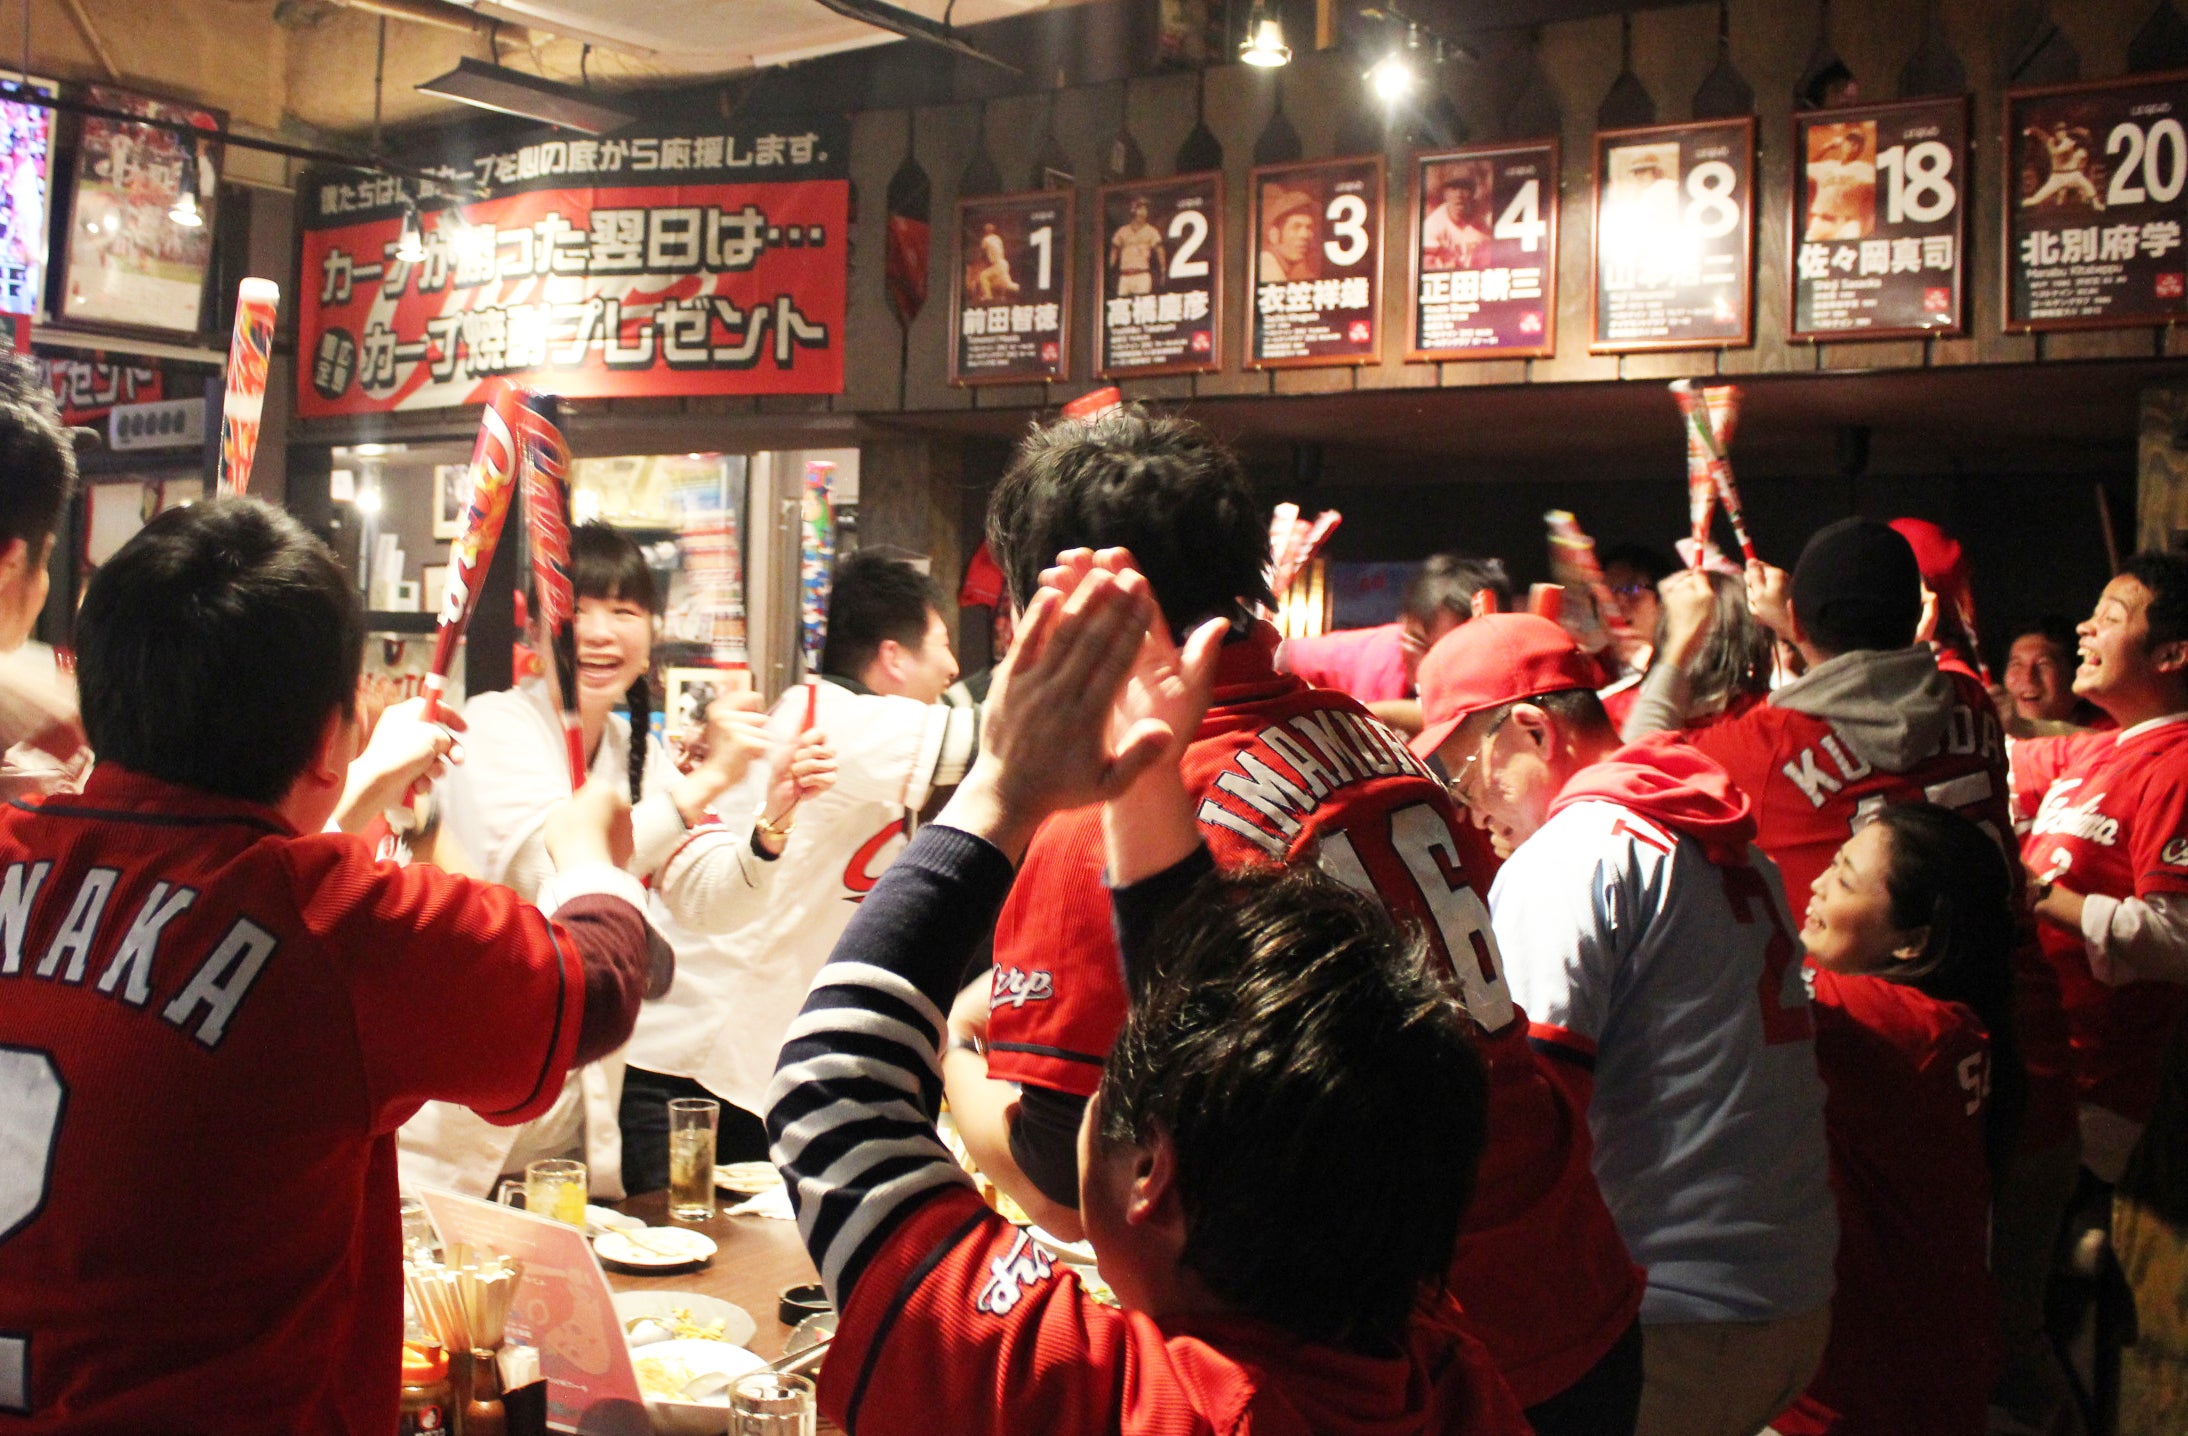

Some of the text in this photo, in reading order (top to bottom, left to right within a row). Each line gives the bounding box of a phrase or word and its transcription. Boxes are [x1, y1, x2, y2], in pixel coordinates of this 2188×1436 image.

[1877, 141, 1956, 224] 18
[2106, 118, 2187, 206] 20
[1323, 194, 1369, 267] 3
[1494, 178, 1546, 252] 4
[1683, 160, 1741, 240] 8
[1029, 226, 1053, 291] 1
[1168, 209, 1210, 279] 2
[1603, 254, 1736, 291] 山二
[1797, 235, 1953, 280] 佐々岡真司
[2020, 220, 2181, 266] 北別府学
[1257, 276, 1369, 314] 衣笠祥雄
[1782, 703, 1998, 809] KUDA
